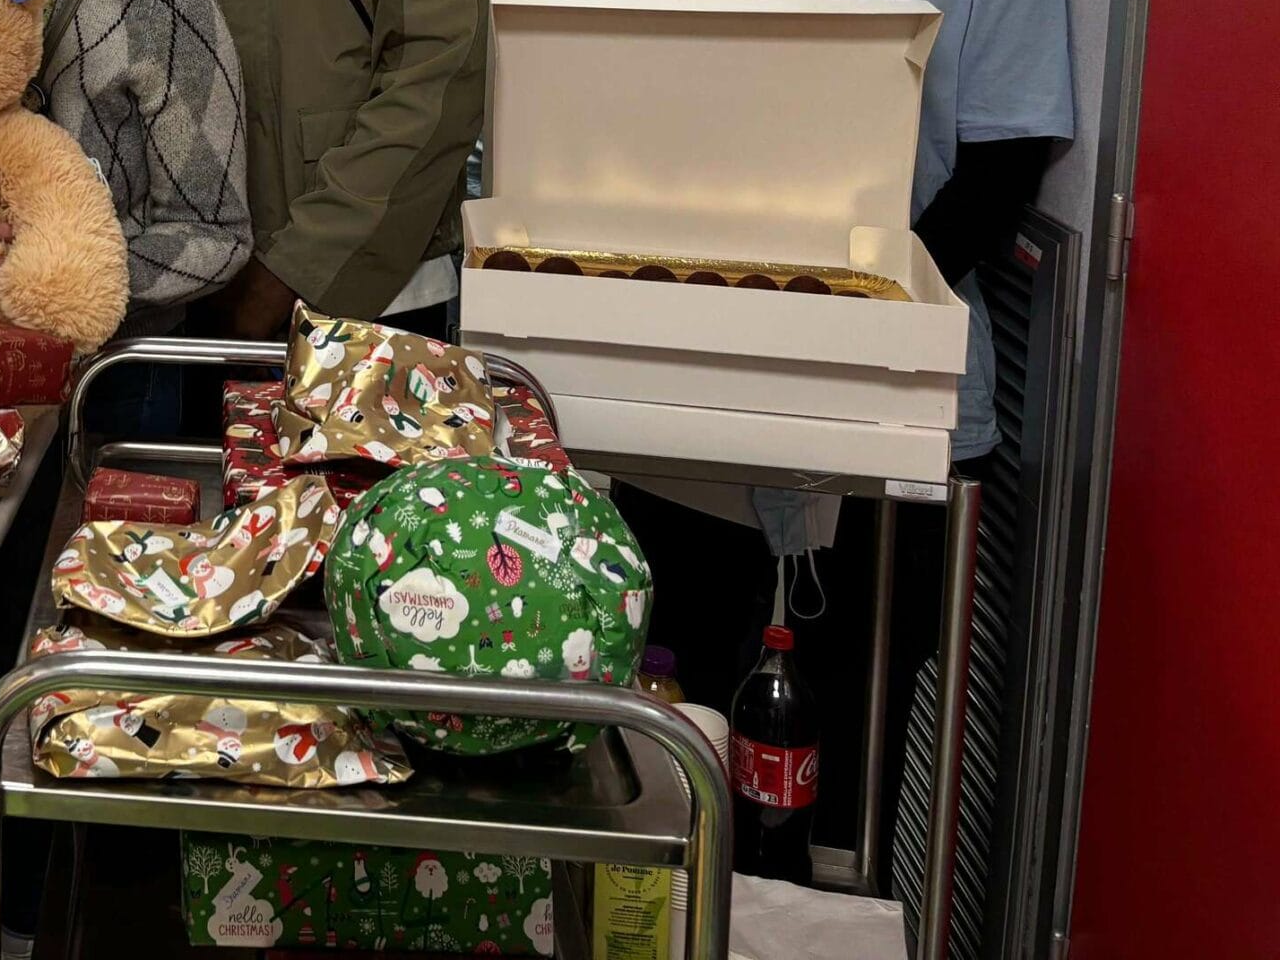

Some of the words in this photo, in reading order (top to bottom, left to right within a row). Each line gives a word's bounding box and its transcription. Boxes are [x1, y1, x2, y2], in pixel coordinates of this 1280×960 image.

[389, 591, 455, 610] CHRISTMAS!
[402, 605, 444, 632] hello
[218, 923, 274, 937] CHRISTMAS!
